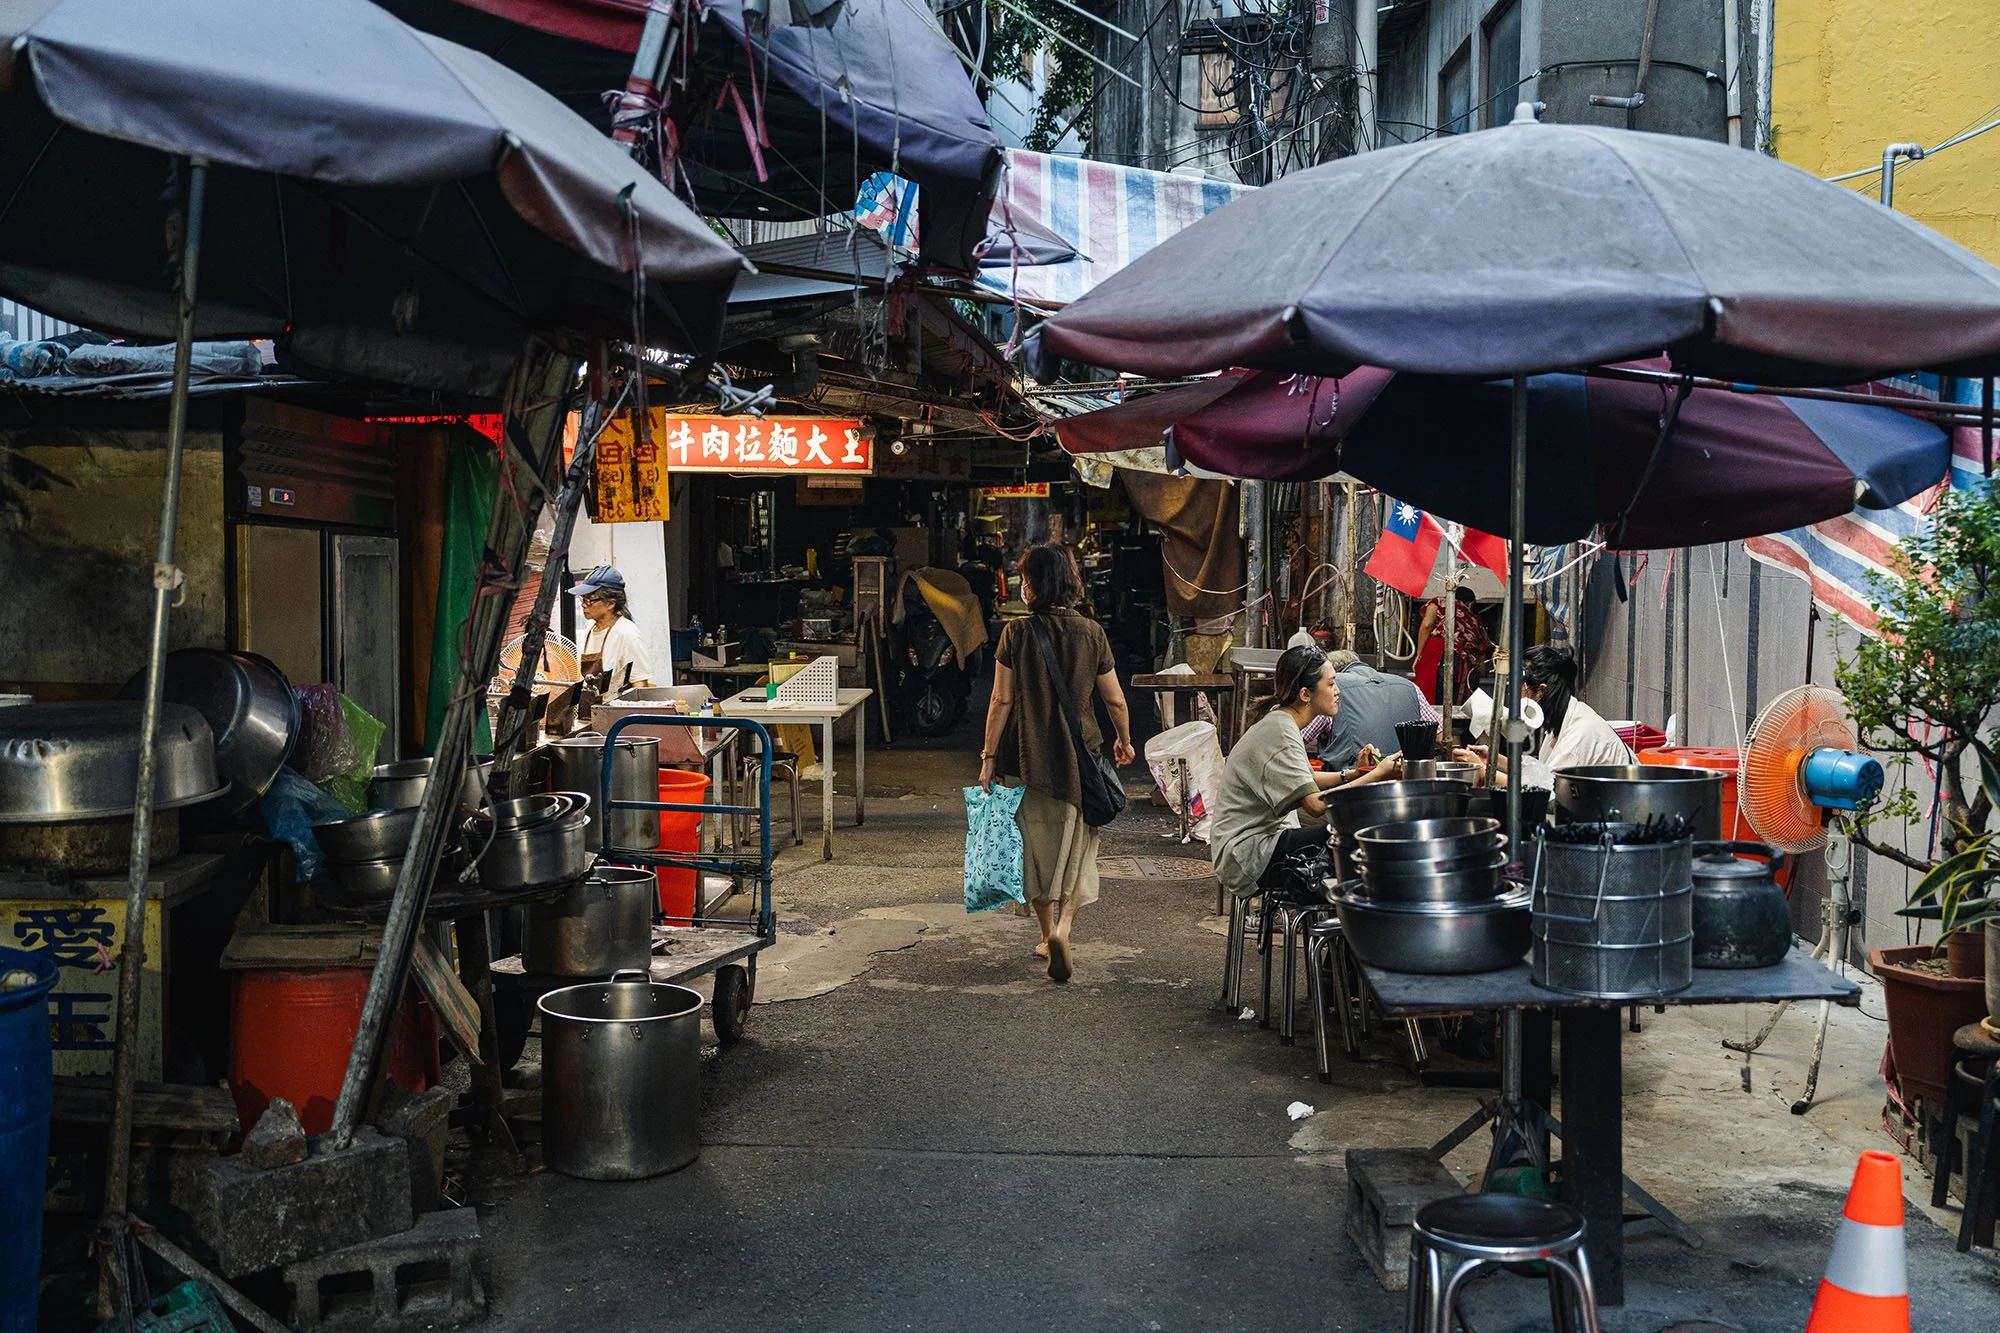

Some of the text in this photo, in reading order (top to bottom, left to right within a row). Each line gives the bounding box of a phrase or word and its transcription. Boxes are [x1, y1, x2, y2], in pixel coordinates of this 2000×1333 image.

[668, 420, 864, 466] 牛肉拉麵大王
[14, 908, 117, 1051] 愛玉
